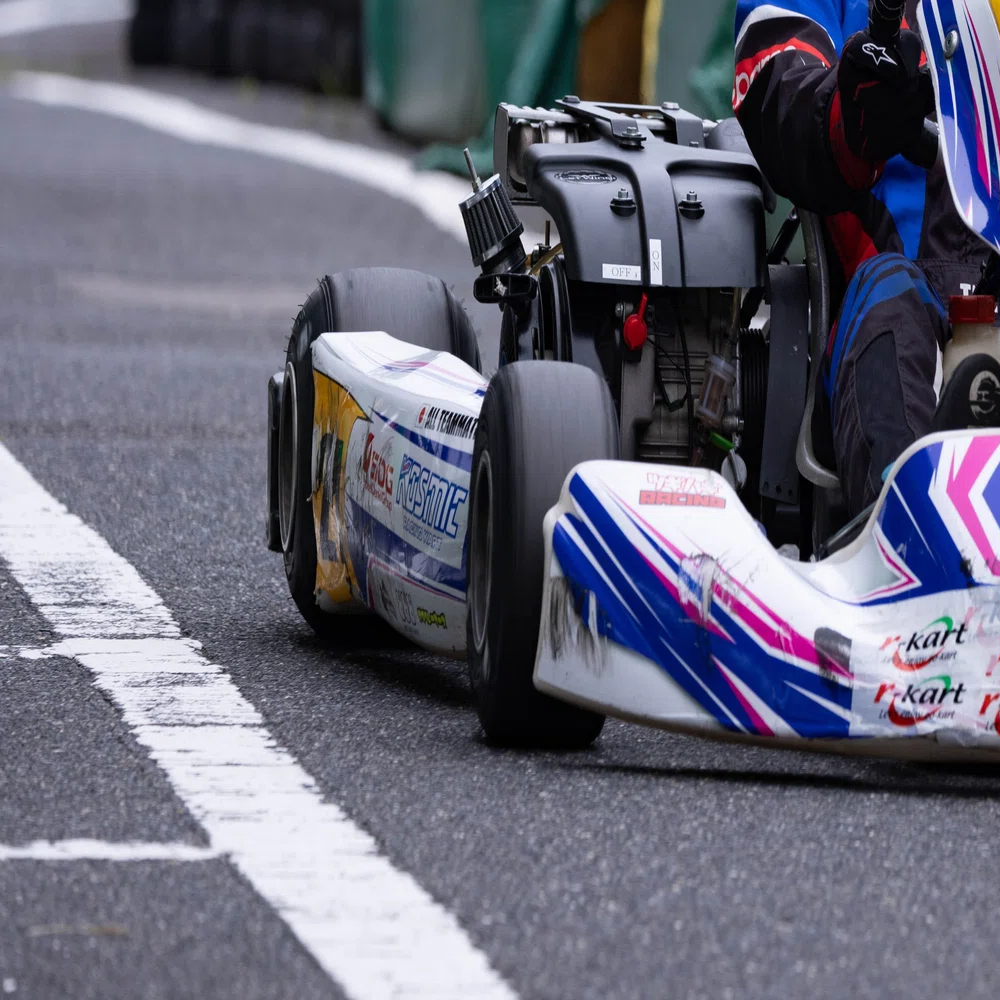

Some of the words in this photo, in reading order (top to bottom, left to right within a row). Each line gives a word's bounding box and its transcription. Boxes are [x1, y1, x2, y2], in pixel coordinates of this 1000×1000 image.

[652, 250, 660, 271] ON
[611, 267, 632, 277] OFF
[424, 406, 440, 431] ALL
[639, 490, 726, 509] RACING
[879, 621, 968, 652] r-kart
[874, 682, 967, 705] r-kart
